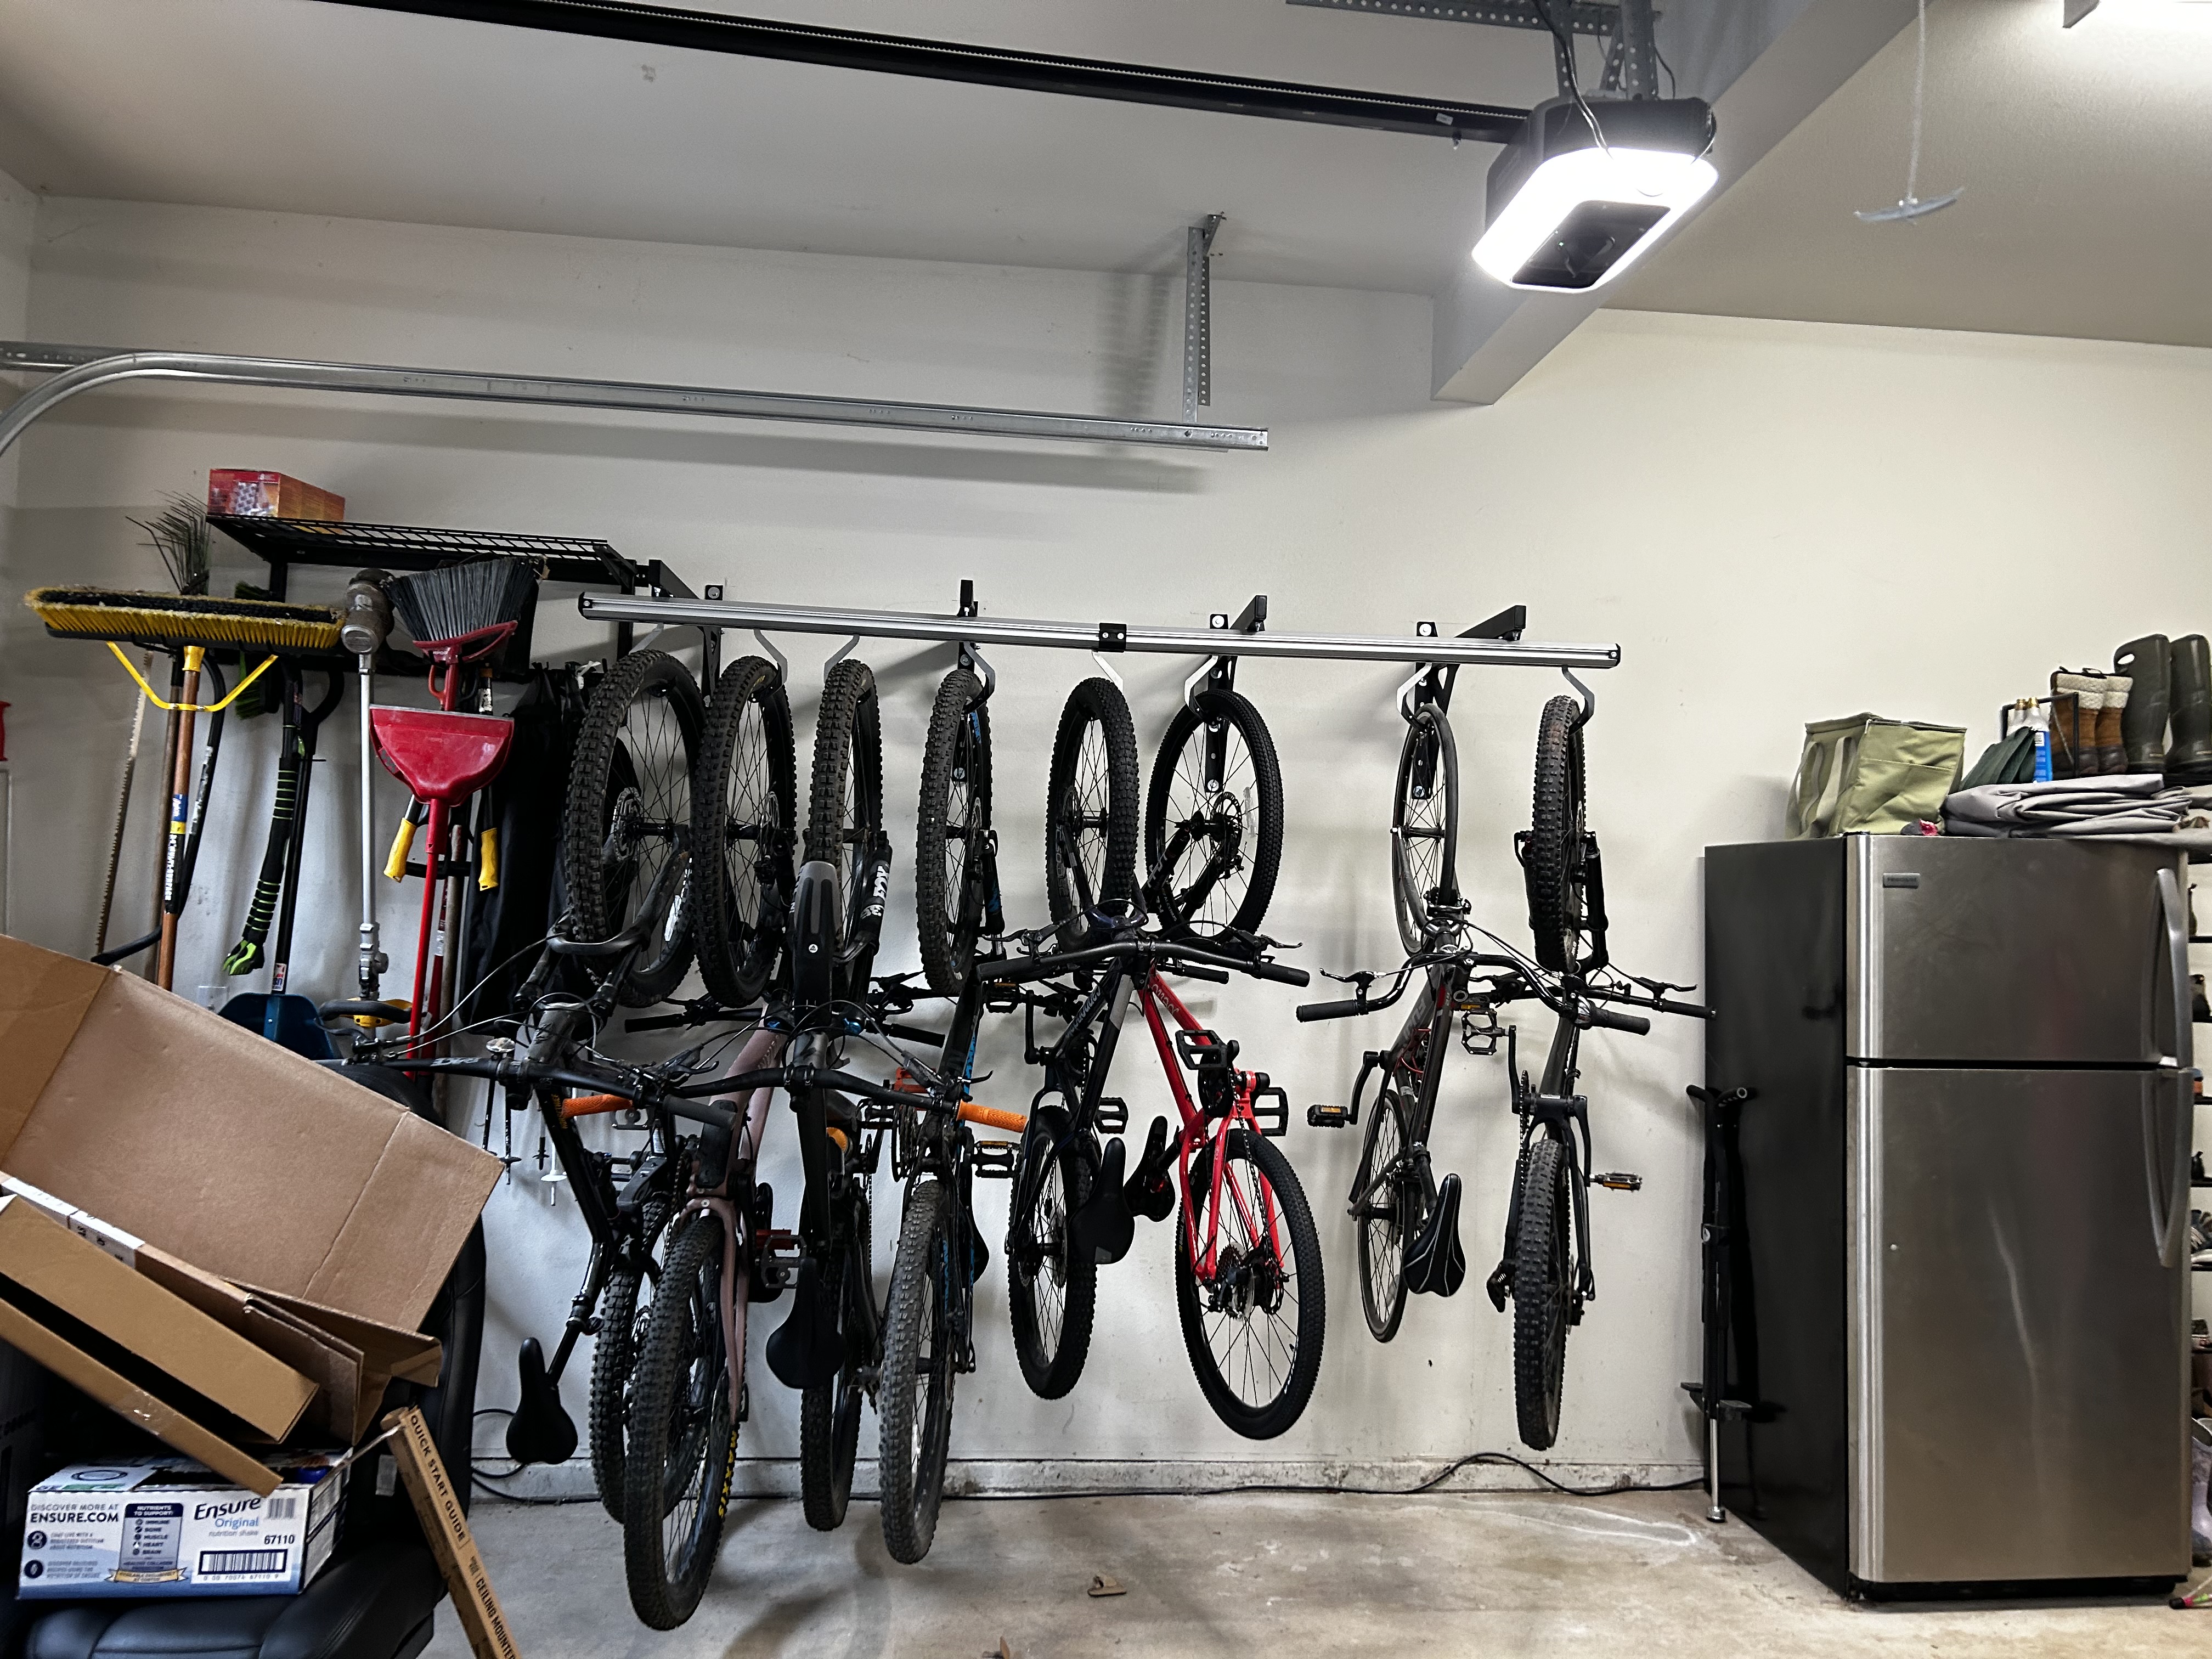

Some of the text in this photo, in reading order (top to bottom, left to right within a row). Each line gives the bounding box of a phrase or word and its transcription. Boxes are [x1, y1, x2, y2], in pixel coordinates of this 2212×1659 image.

[873, 865, 890, 900] FOX
[411, 1415, 465, 1542] QUICK START GUIDE
[718, 1430, 737, 1519] MAXXIS
[30, 1513, 119, 1522] ENSURE.COM
[194, 1498, 261, 1520] Ensure
[215, 1516, 259, 1530] Original
[264, 1534, 296, 1544] 67110
[476, 1576, 496, 1618] CEILING
